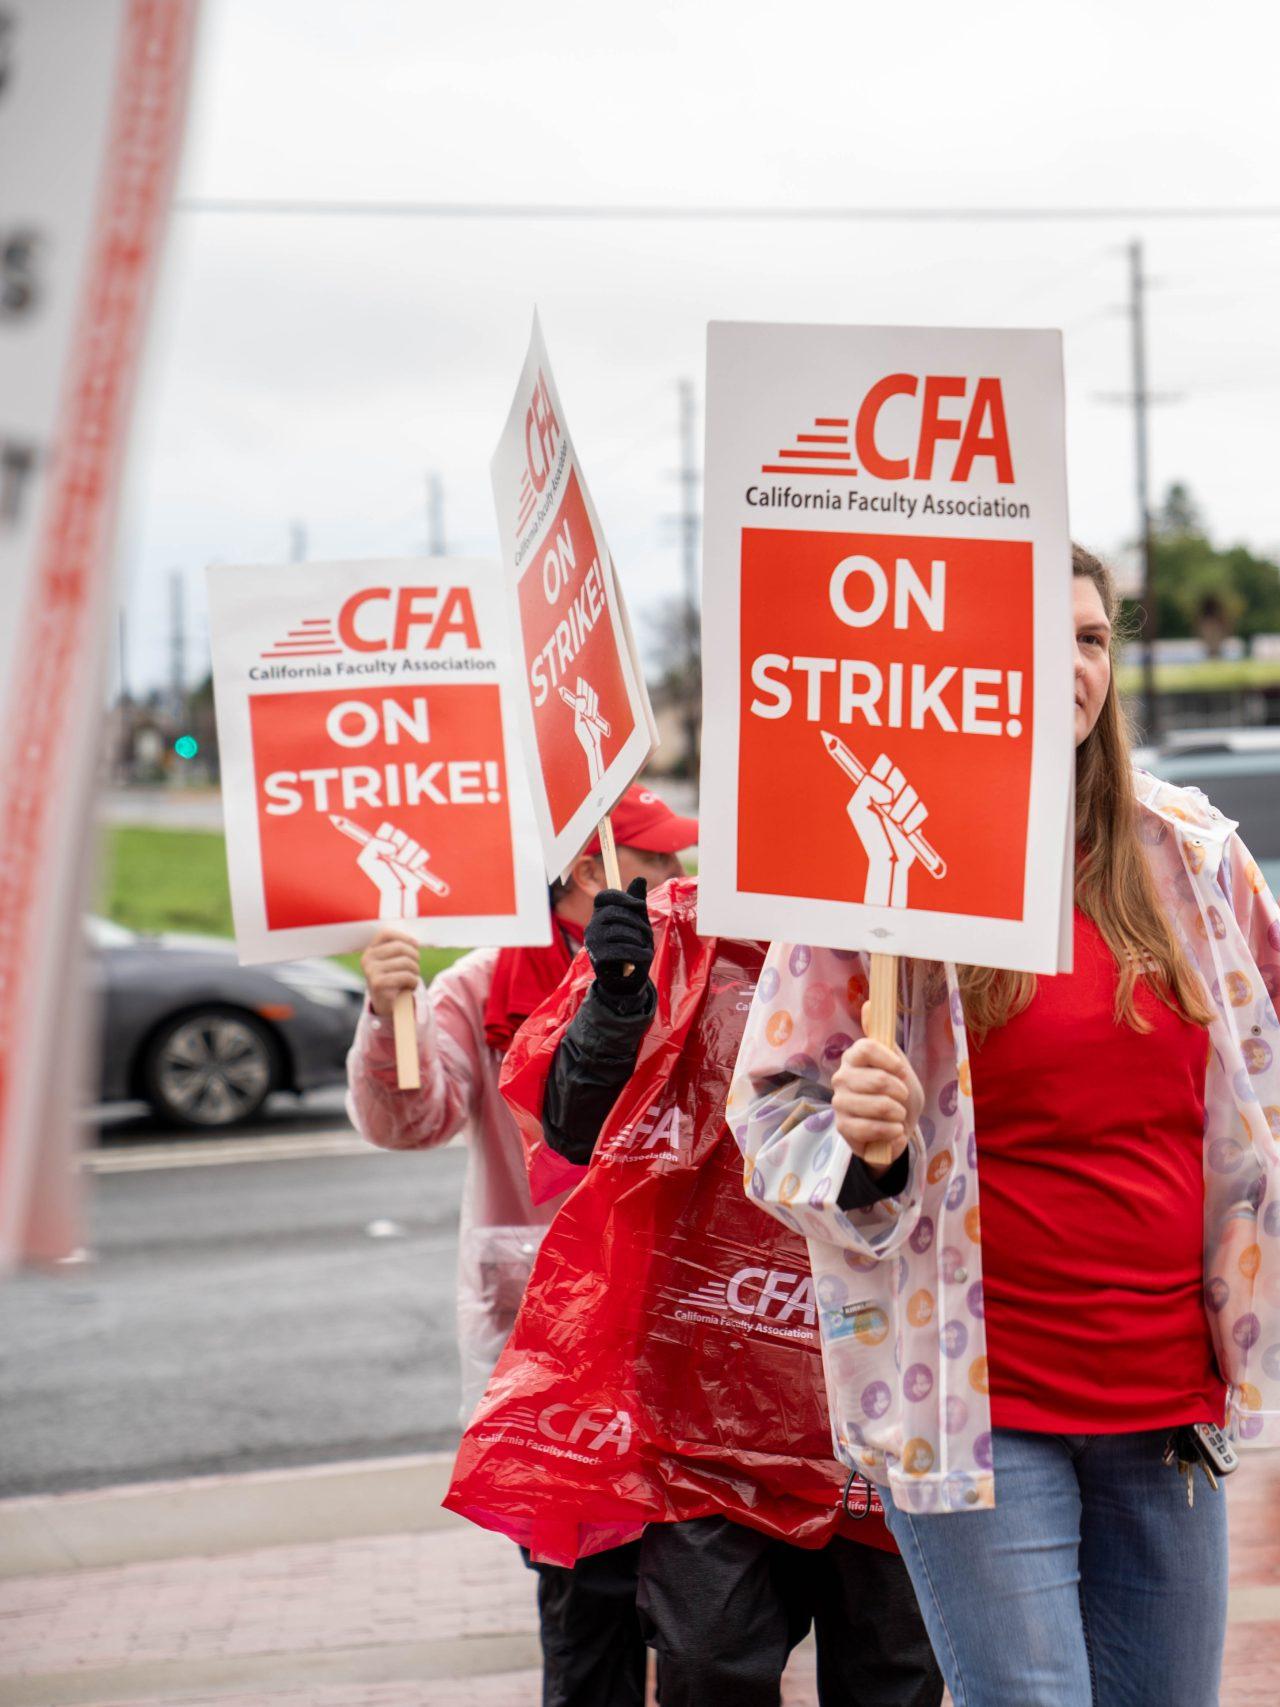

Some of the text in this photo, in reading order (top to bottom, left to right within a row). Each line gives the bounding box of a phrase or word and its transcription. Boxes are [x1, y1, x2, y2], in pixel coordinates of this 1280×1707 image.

[525, 366, 562, 494] CFA
[855, 373, 1015, 483] CFA
[745, 487, 1030, 519] California Faculty Association
[542, 519, 576, 605] ON
[338, 586, 482, 653] CFA
[829, 555, 946, 632] ON
[531, 556, 607, 707] STRIKE!
[249, 656, 496, 681] California Faculty Association
[750, 653, 1024, 738] STRIKE!
[326, 697, 431, 748] ON
[264, 761, 501, 816] STRIKE!
[626, 1103, 680, 1149] FA
[674, 1310, 814, 1340] California Faculty Association
[726, 1267, 816, 1326] CFA
[478, 1433, 601, 1466] California Faculty Associ
[537, 1403, 632, 1456] CFA
